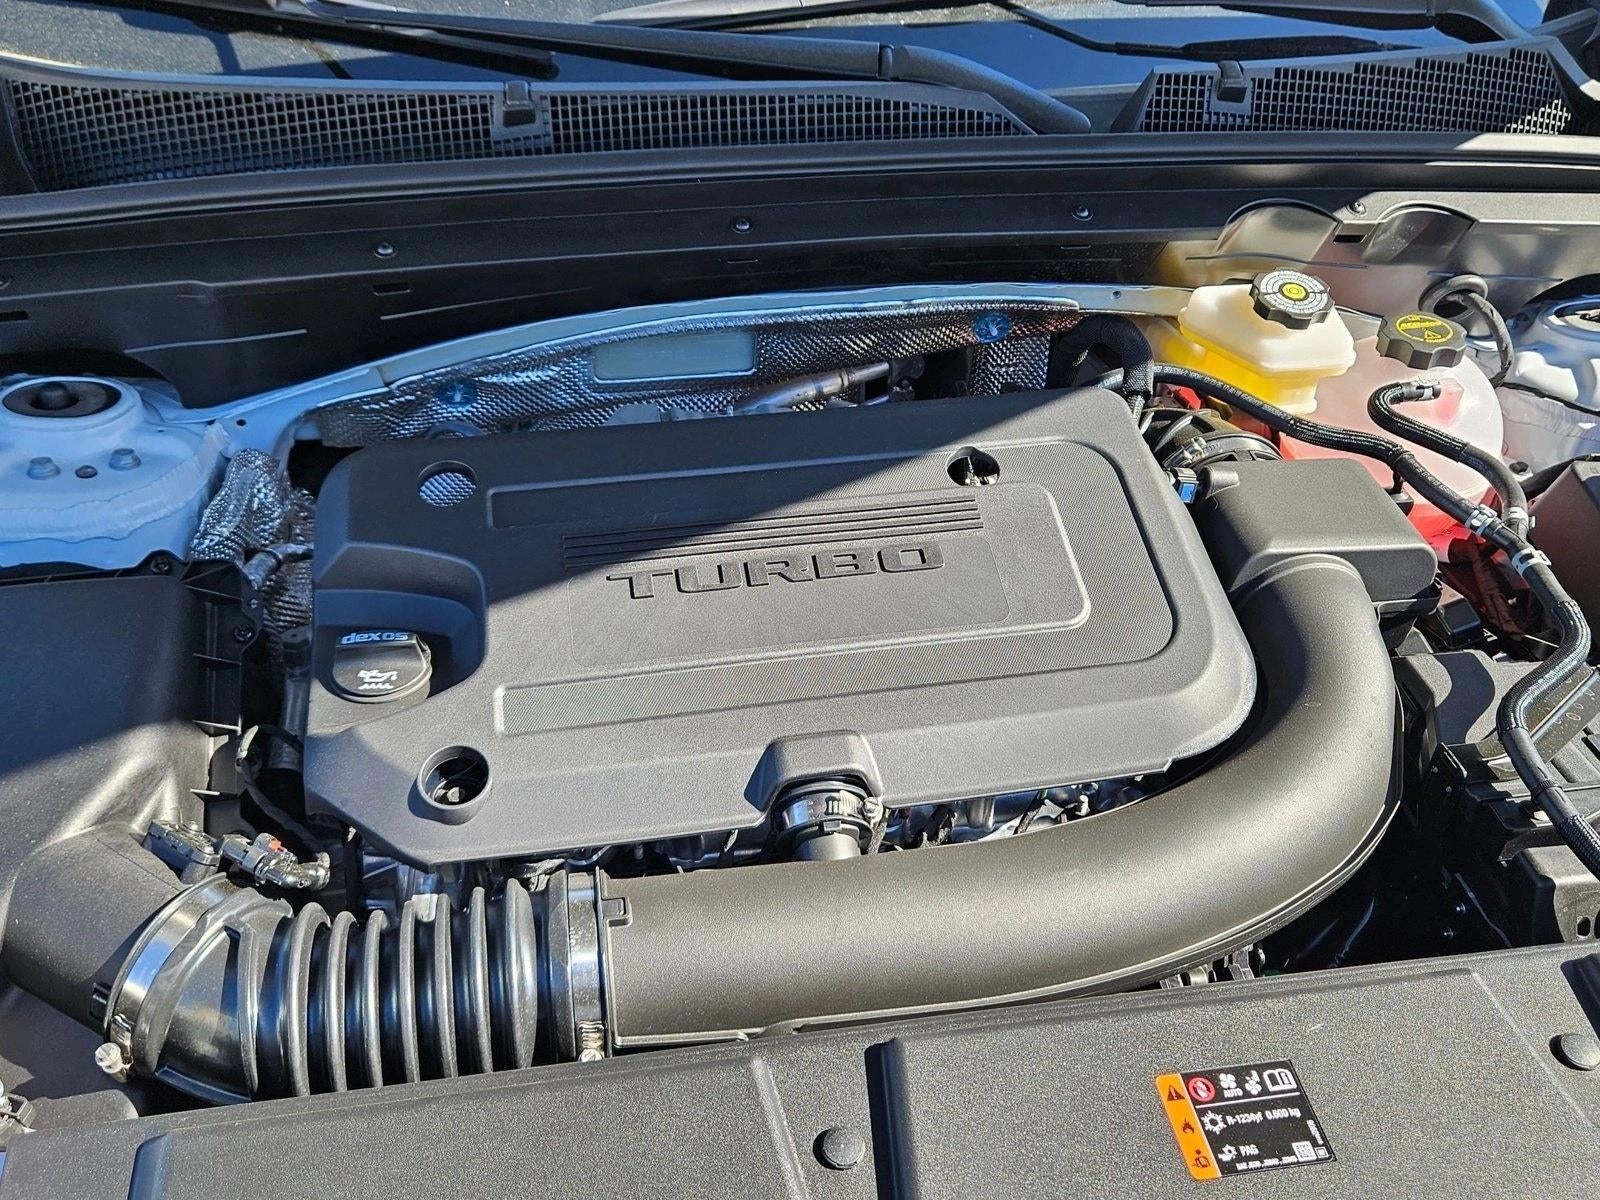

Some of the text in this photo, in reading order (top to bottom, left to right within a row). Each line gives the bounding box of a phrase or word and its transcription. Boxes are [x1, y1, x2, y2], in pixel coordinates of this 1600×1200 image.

[606, 542, 946, 600] TURBO
[340, 632, 409, 645] dexos
[1224, 1088, 1243, 1098] AUTO
[1288, 1108, 1301, 1118] kg
[1239, 1144, 1259, 1157] PAG
